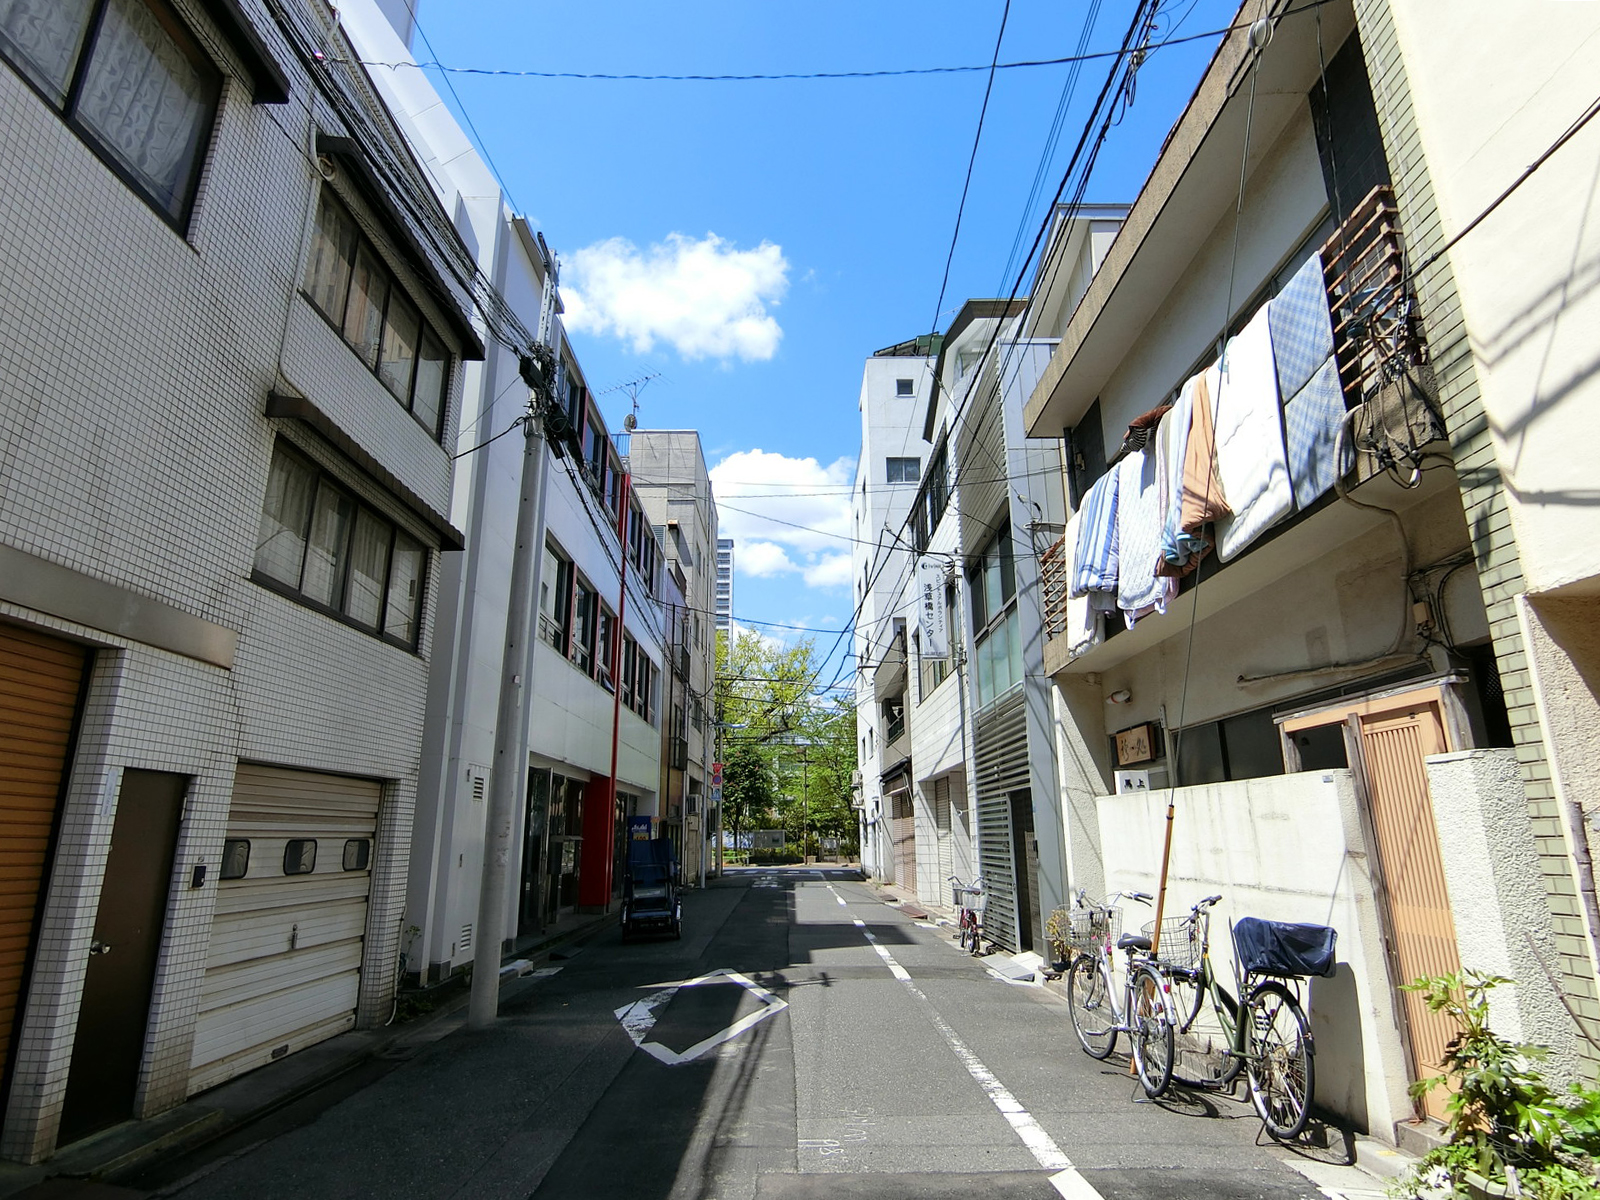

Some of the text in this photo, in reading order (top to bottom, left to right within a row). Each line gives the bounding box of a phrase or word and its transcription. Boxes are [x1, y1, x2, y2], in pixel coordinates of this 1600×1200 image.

[924, 583, 934, 647] 浅草橋センター
